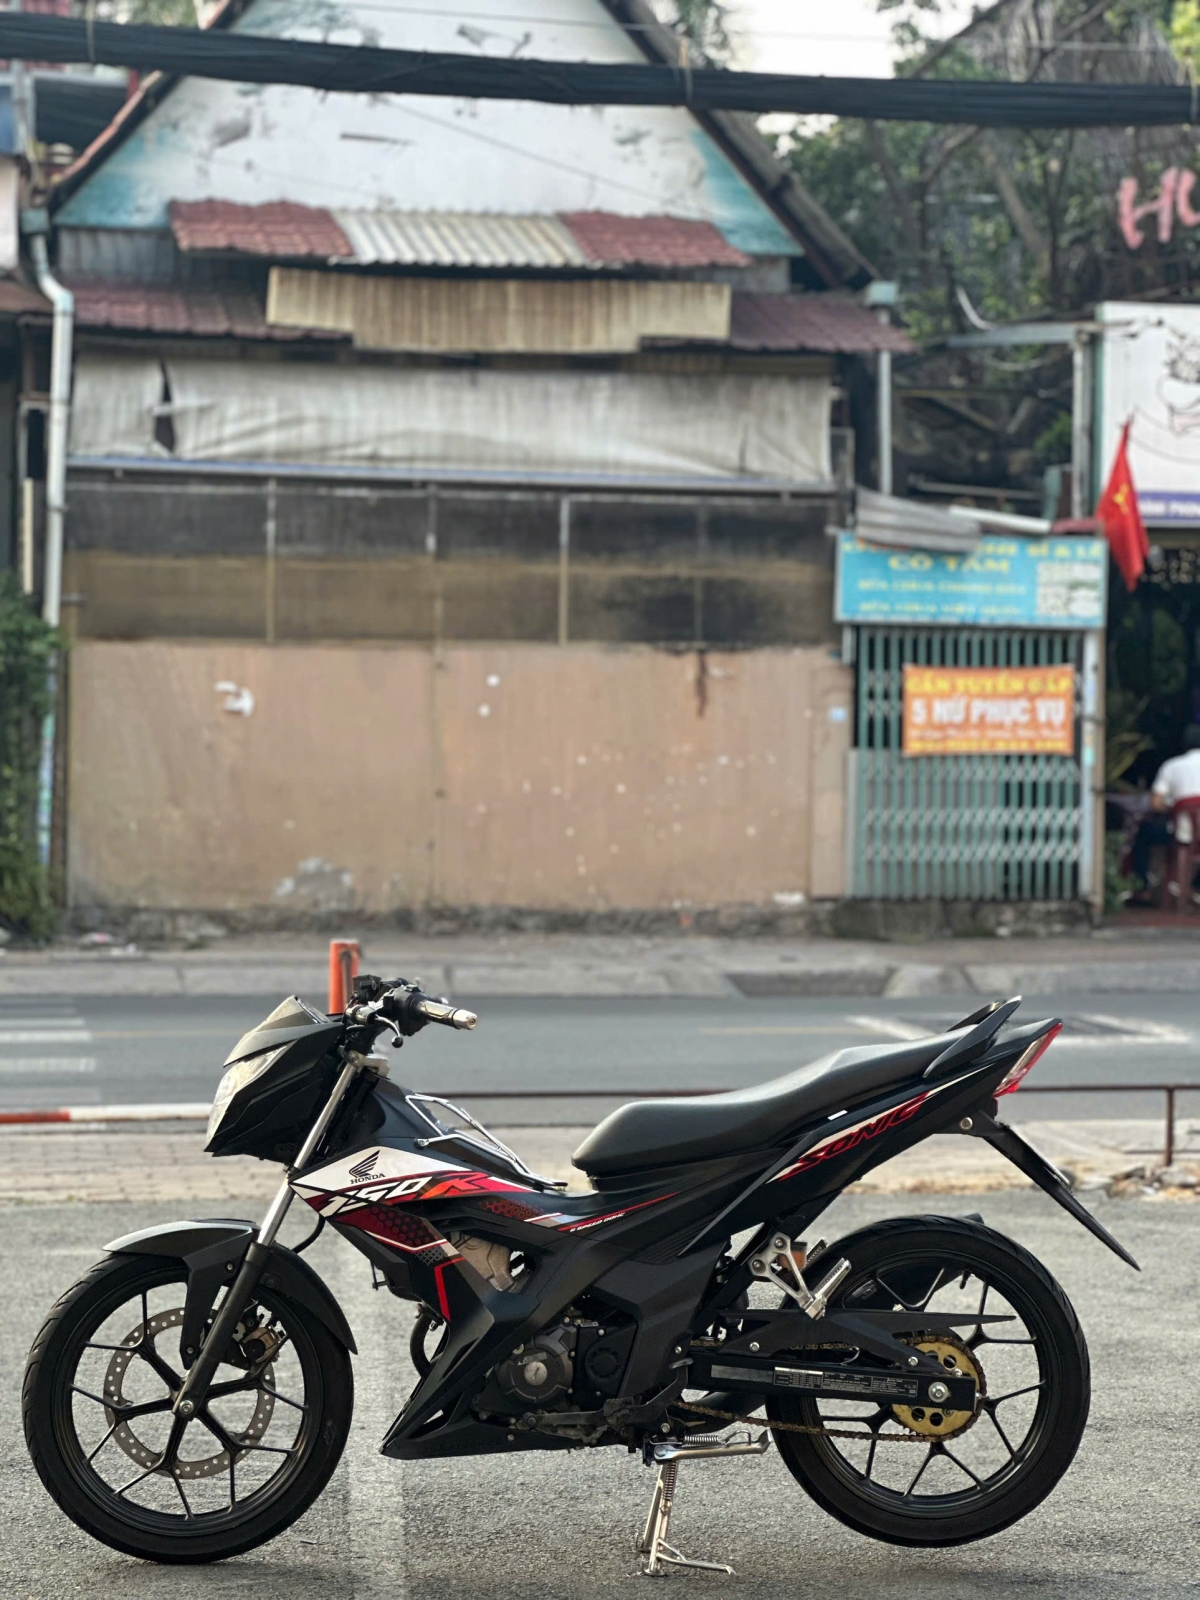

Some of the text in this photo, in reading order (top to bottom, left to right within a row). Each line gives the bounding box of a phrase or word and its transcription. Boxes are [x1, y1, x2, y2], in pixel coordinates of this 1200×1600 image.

[911, 694, 1066, 727] 5 NỮ PHỤC VỤ
[797, 1091, 930, 1167] SONIC
[350, 1173, 387, 1184] HONDA
[577, 1219, 603, 1230] SPEED
